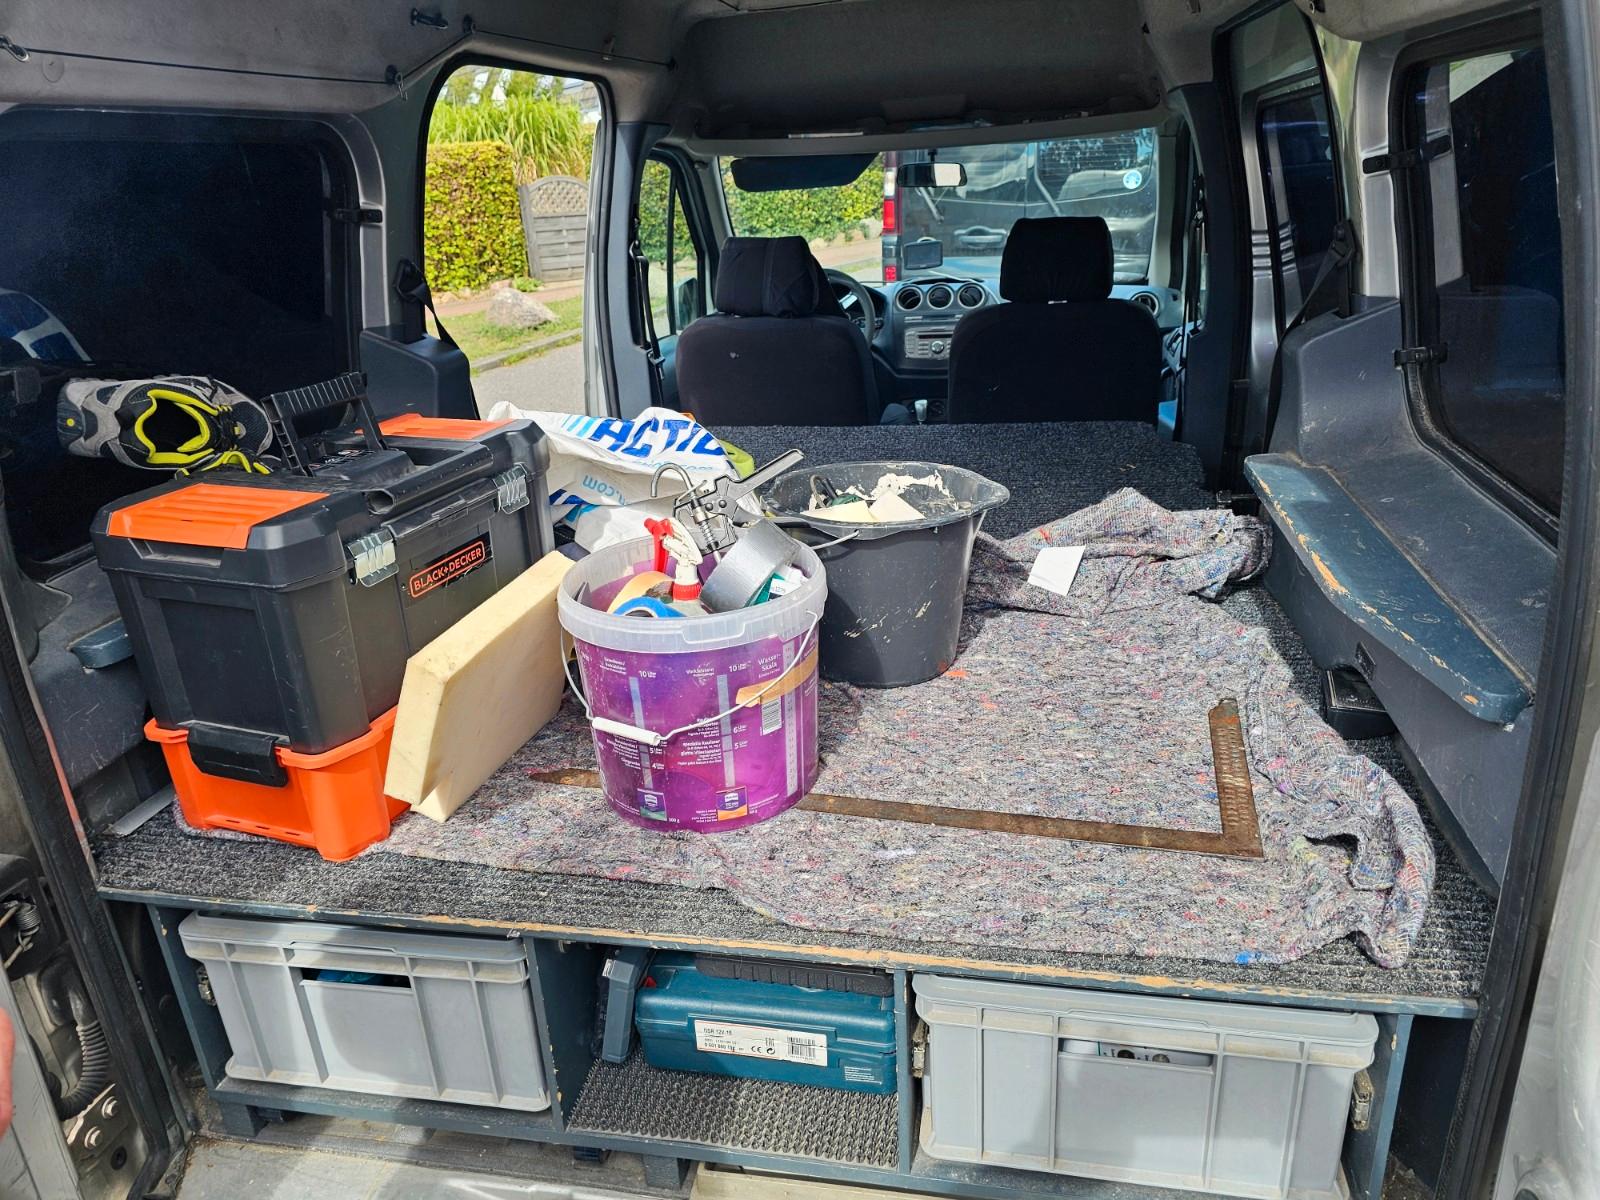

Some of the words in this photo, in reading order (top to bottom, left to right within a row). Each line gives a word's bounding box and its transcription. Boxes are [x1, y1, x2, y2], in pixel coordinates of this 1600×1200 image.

[414, 547, 482, 592] BLACK+DECKER
[728, 664, 738, 673] 10
[761, 661, 778, 672] Skala
